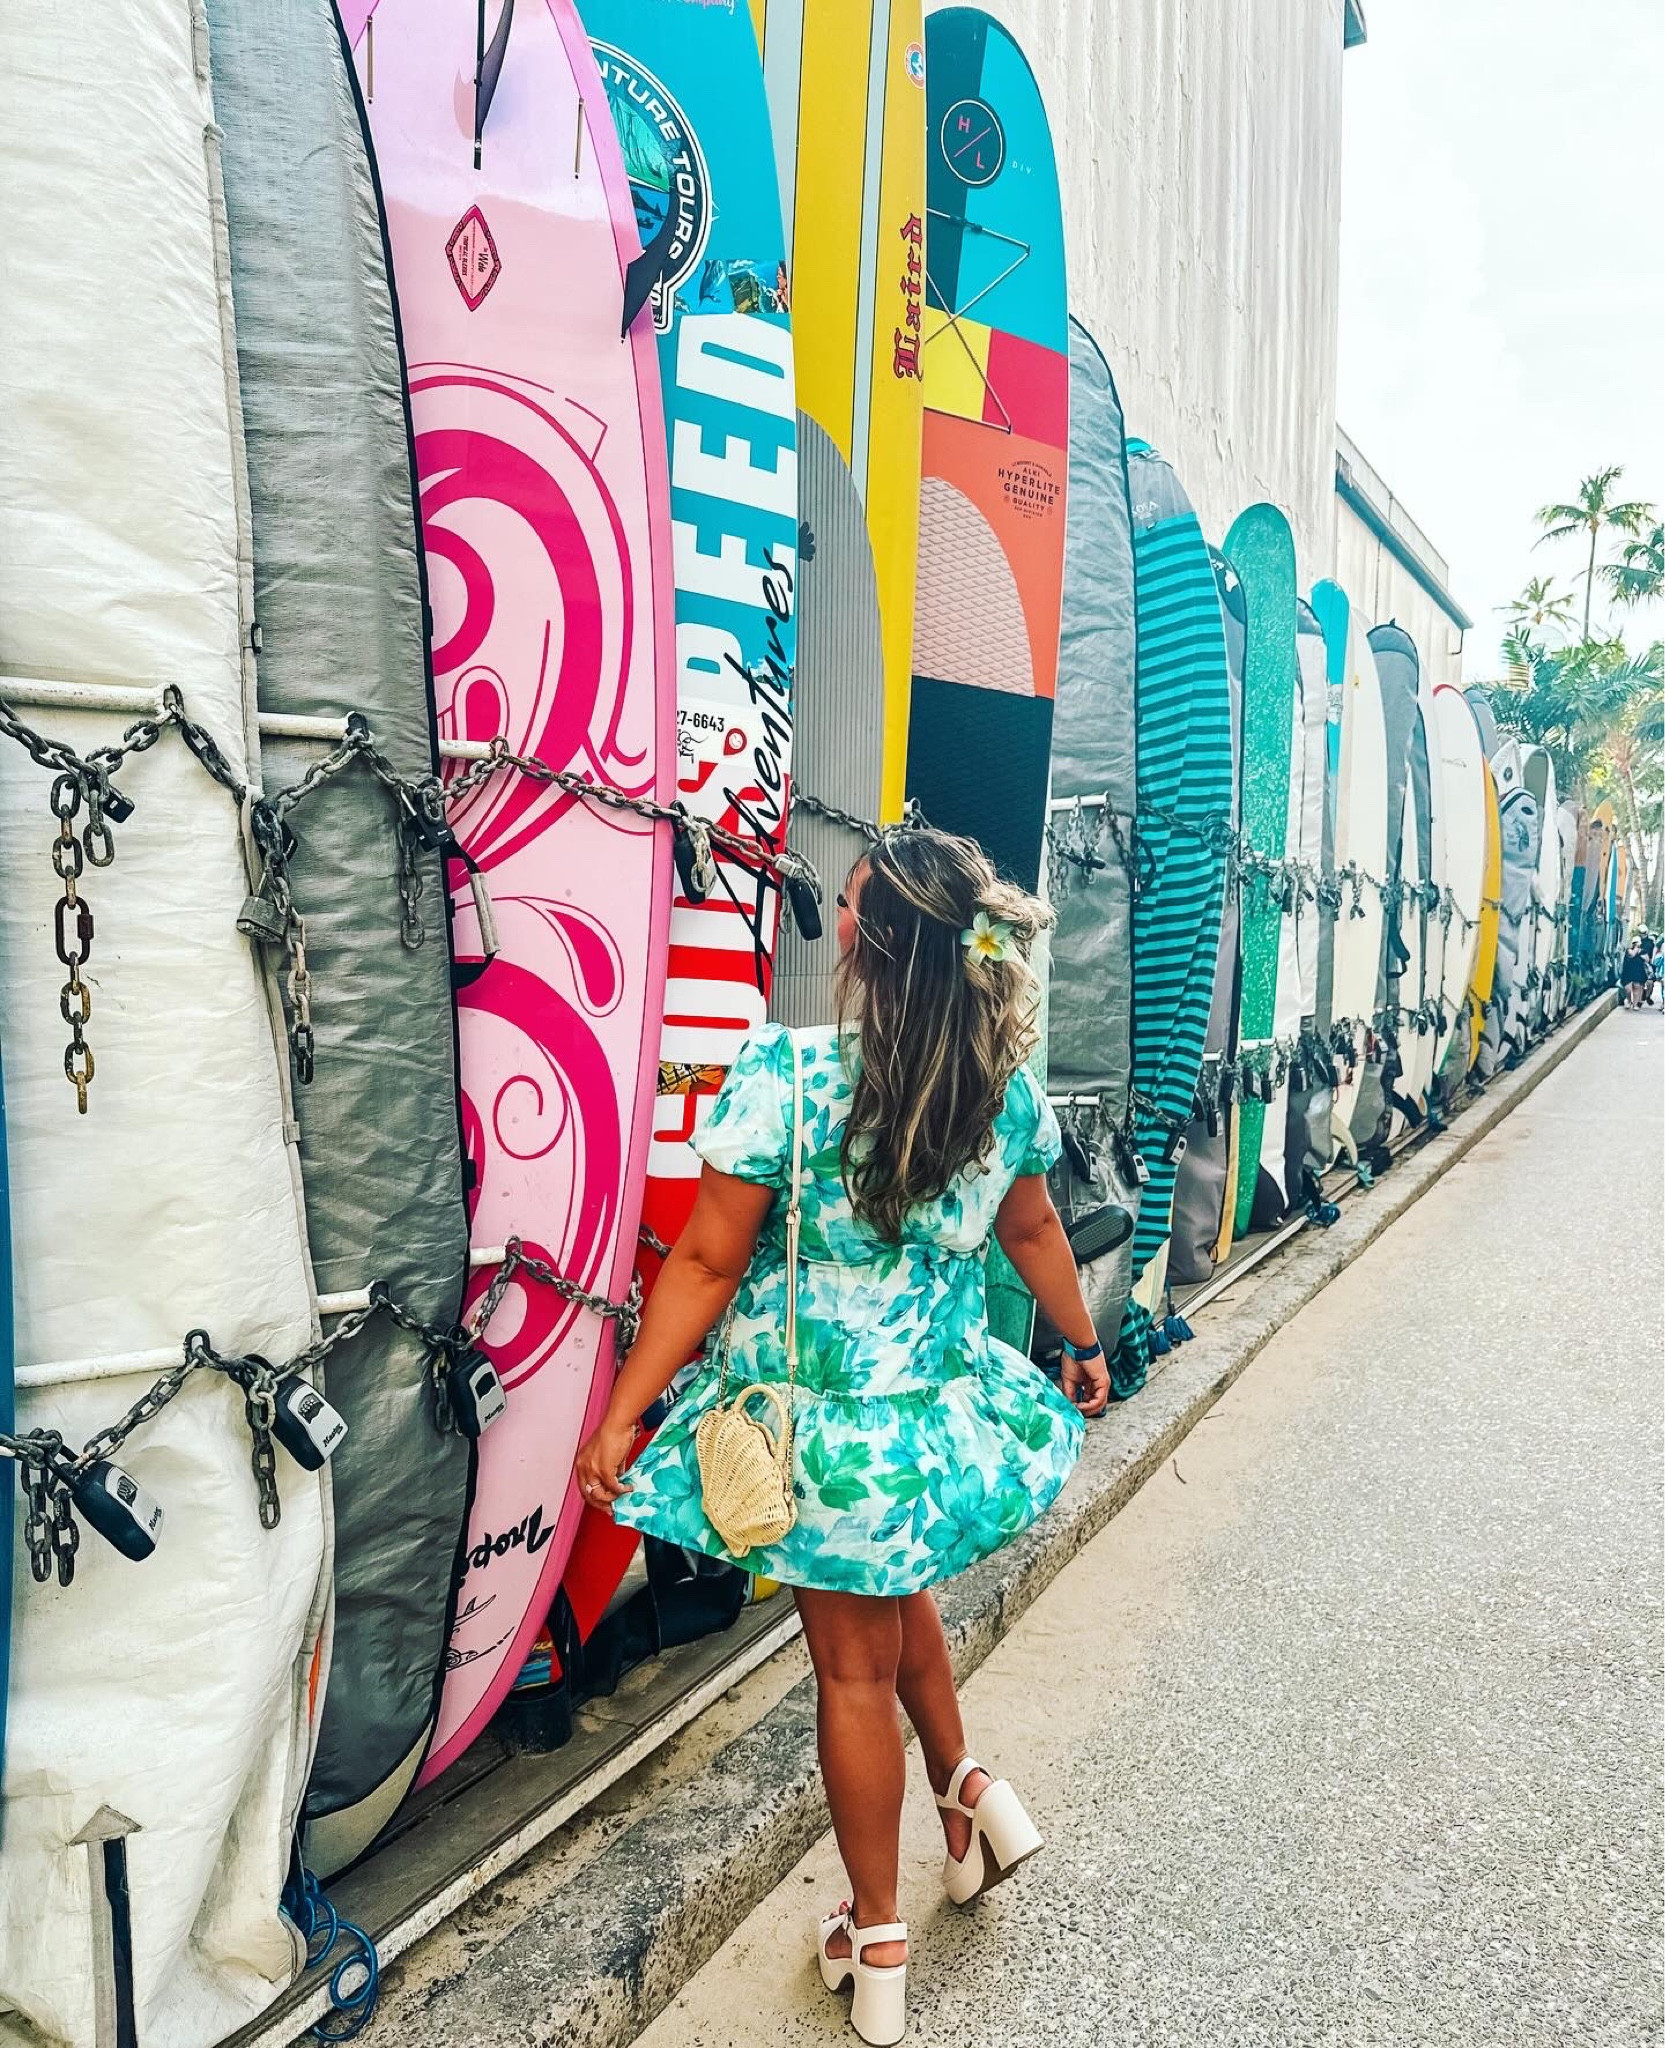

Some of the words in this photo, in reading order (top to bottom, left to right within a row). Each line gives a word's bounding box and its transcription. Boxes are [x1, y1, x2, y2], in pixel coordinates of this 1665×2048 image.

[957, 115, 971, 133] H
[975, 151, 985, 169] L
[893, 212, 924, 383] Laird
[998, 467, 1061, 496] HYPERLITE
[1003, 482, 1055, 506] GENUINE
